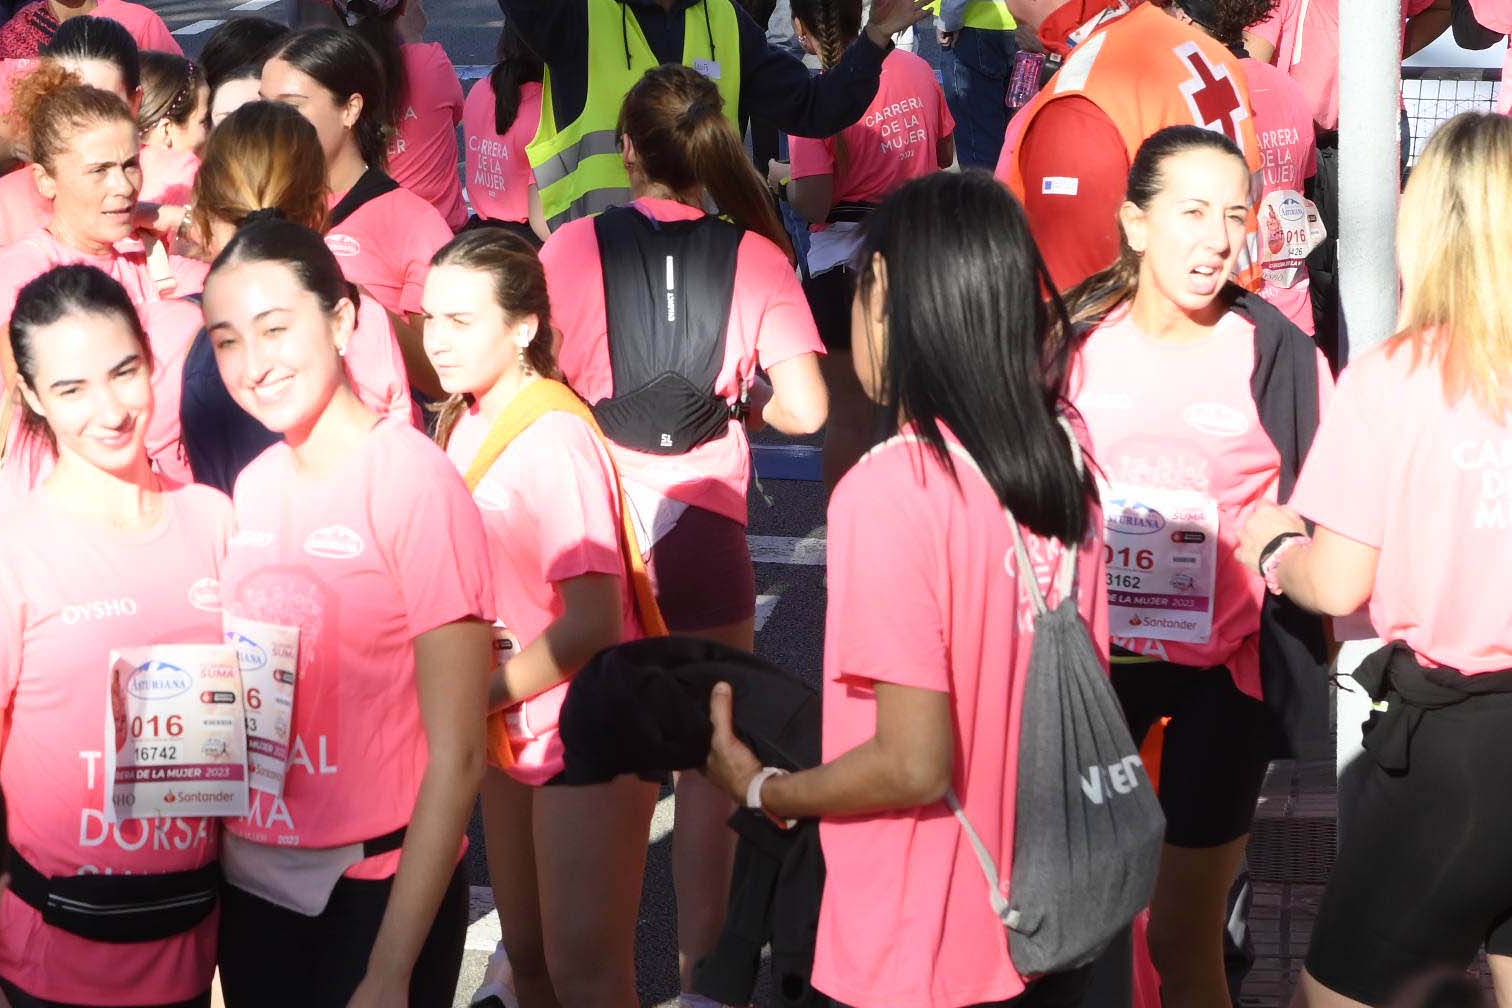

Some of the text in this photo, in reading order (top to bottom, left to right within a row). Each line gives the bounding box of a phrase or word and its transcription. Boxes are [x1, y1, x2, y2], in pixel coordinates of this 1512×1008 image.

[865, 95, 924, 128] CARRERA
[882, 114, 919, 137] DE LA
[880, 128, 927, 155] MUJER
[1277, 150, 1292, 165] LA
[489, 159, 502, 173] LA
[474, 172, 506, 192] MUJER
[1286, 229, 1306, 244] 016
[1119, 594, 1195, 608] LA MUJER 2023
[61, 597, 138, 626] OYSHO
[1143, 616, 1198, 631] Santander
[200, 668, 235, 680] SUMA
[131, 714, 185, 739] 016
[135, 745, 177, 762] 16742
[136, 767, 231, 780] DE LA MUJER 2023
[176, 791, 235, 805] Santander
